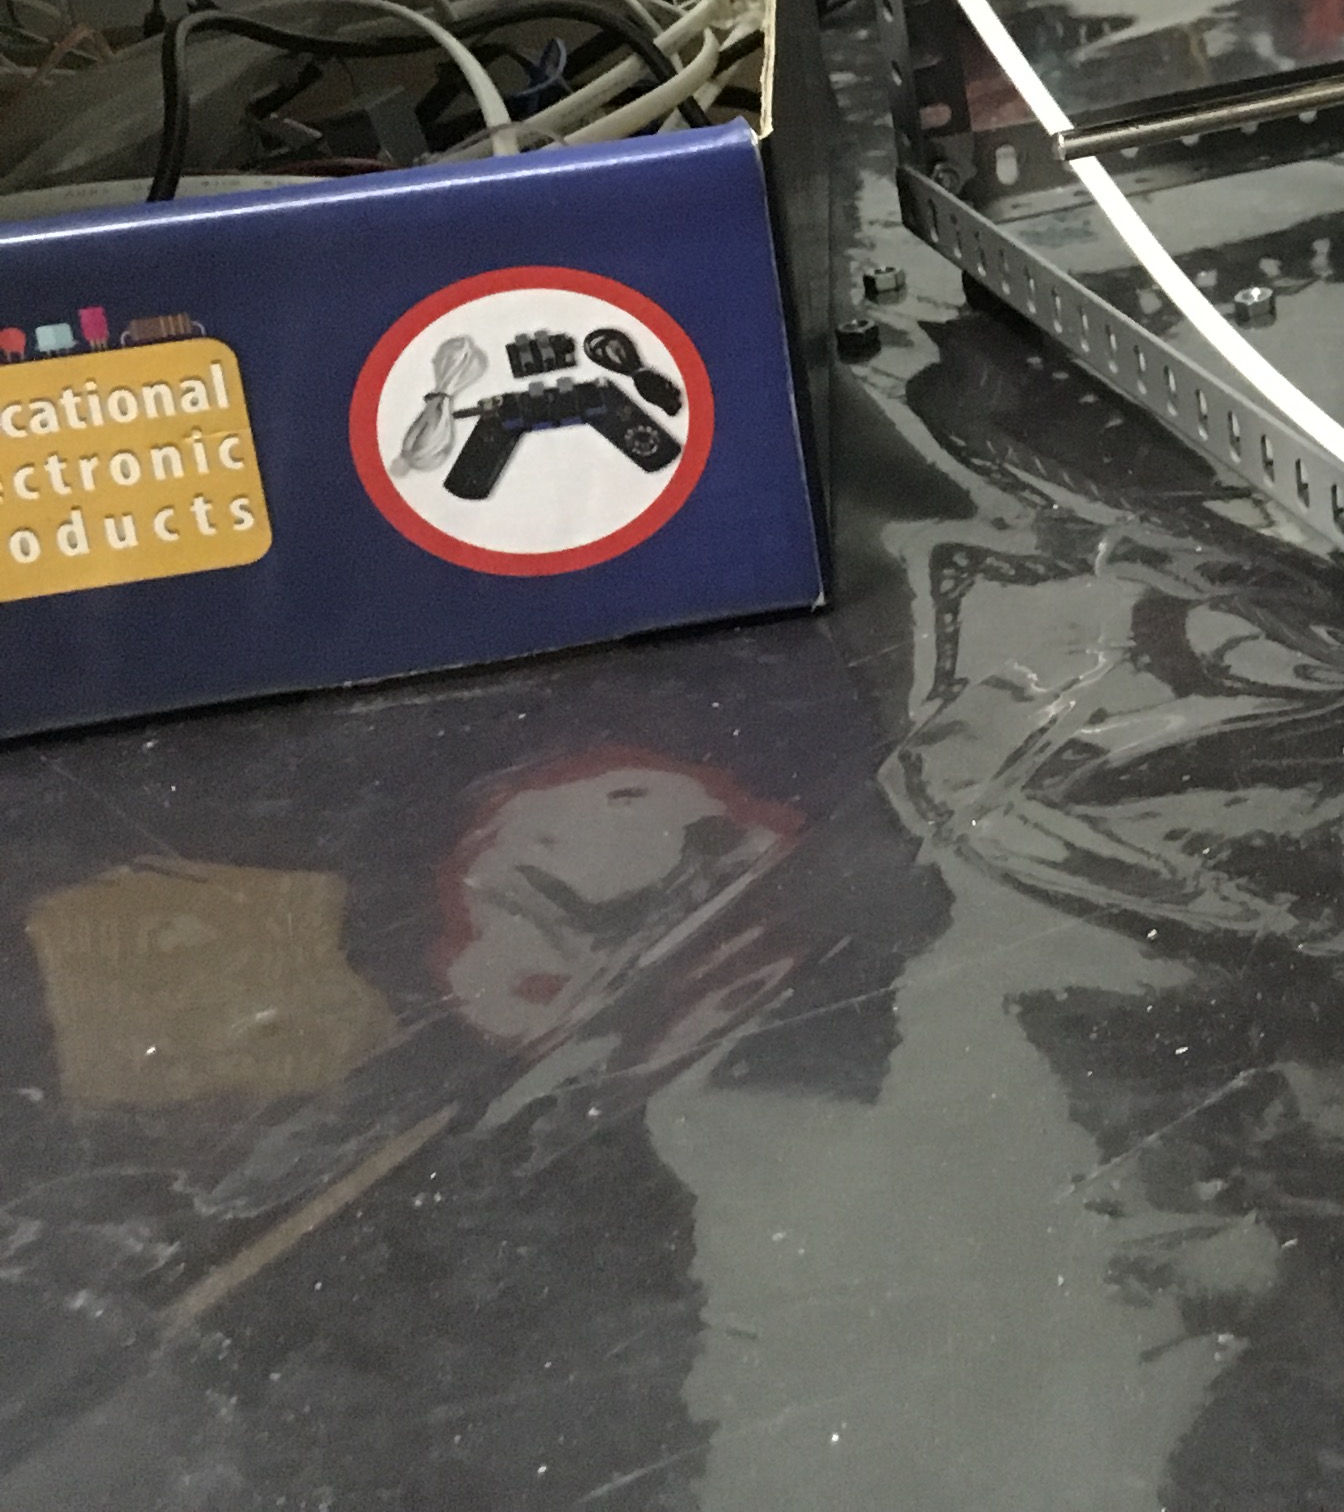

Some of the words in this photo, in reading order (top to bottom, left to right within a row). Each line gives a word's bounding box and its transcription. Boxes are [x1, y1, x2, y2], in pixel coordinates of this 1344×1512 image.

[0, 361, 230, 438] cational
[0, 428, 244, 503] ctronic
[8, 495, 255, 564] oducts
